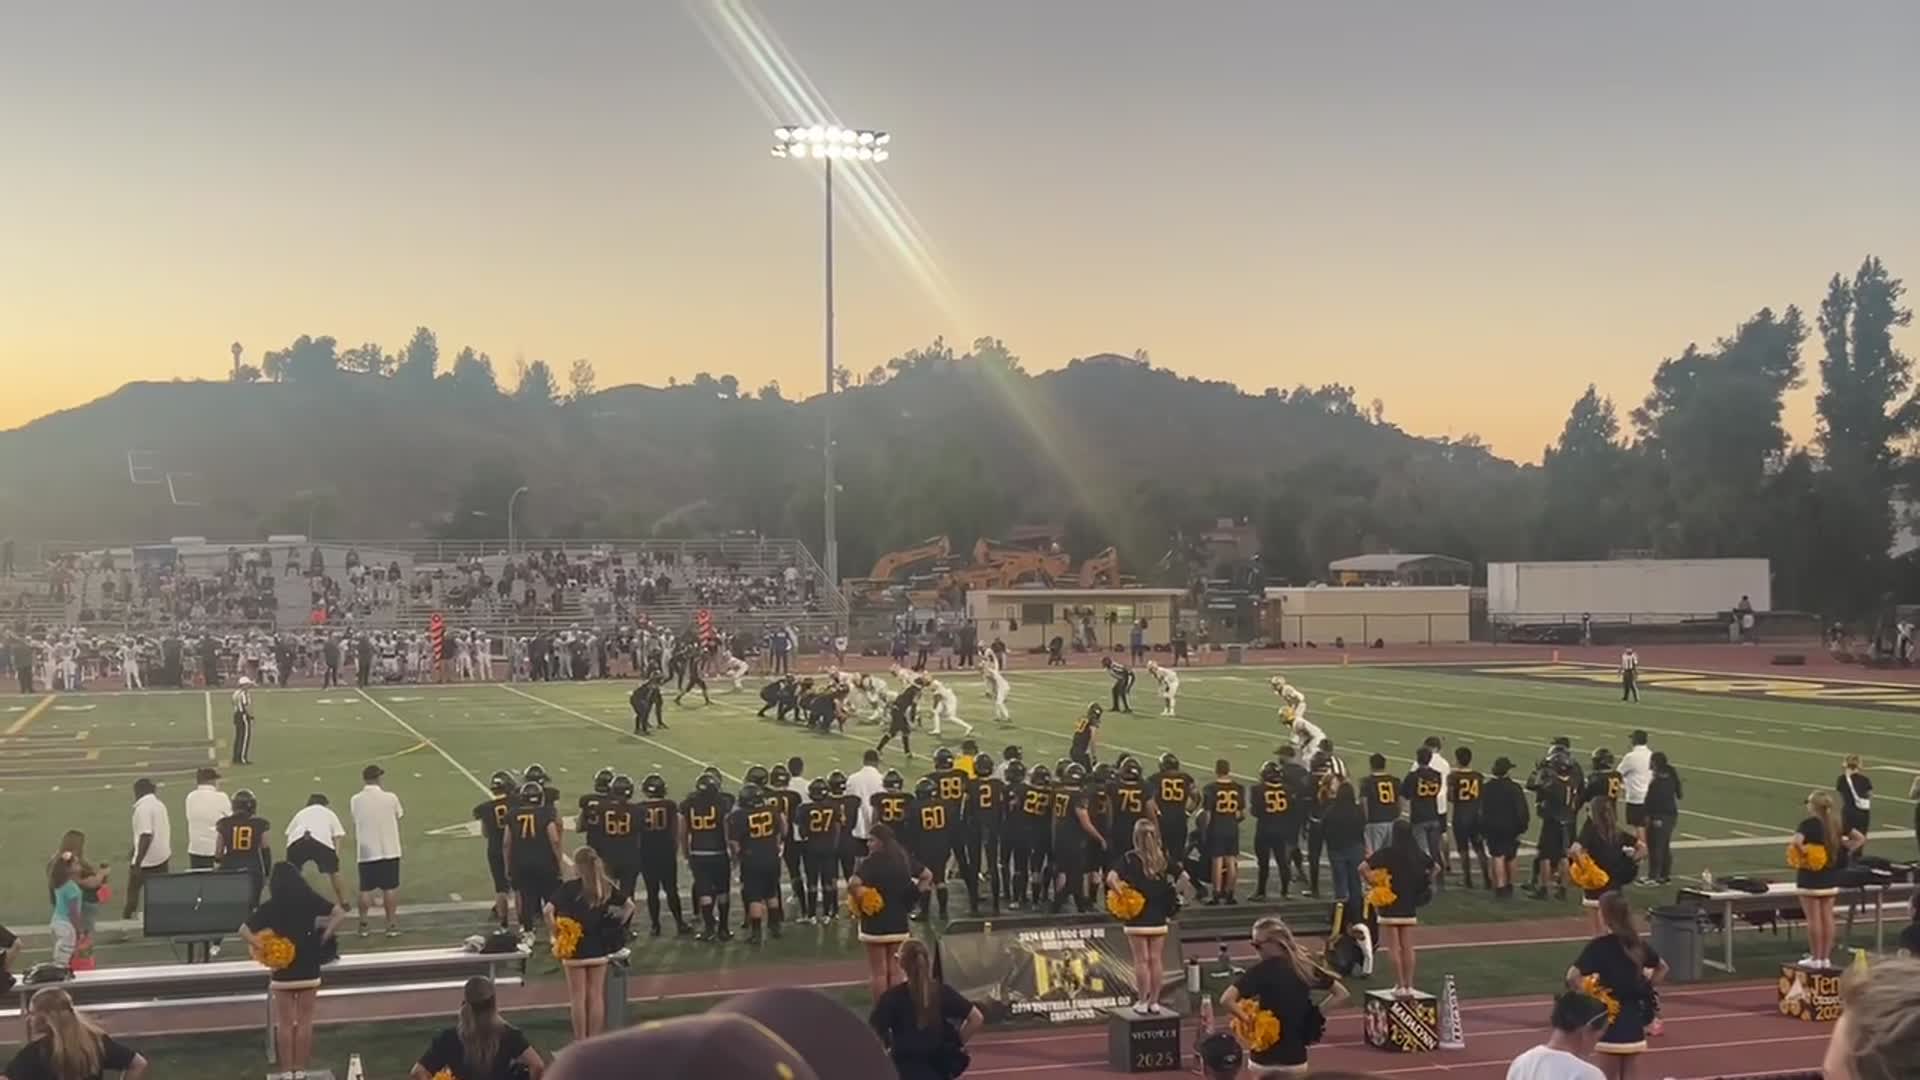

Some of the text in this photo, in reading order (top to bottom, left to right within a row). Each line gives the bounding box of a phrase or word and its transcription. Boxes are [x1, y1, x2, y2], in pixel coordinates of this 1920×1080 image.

[940, 777, 962, 799] 89
[979, 785, 991, 807] 2
[1161, 778, 1184, 800] 65
[1378, 781, 1394, 803] 61
[1459, 779, 1478, 800] 24
[881, 799, 905, 821] 35
[1118, 789, 1141, 812] 75
[1216, 790, 1238, 812] 26
[1264, 790, 1287, 812] 56
[517, 814, 536, 838] 71
[748, 812, 773, 837] 52
[810, 809, 833, 831] 27
[921, 807, 945, 829] 60
[233, 826, 252, 849] 18
[1136, 1052, 1175, 1068] 2025
